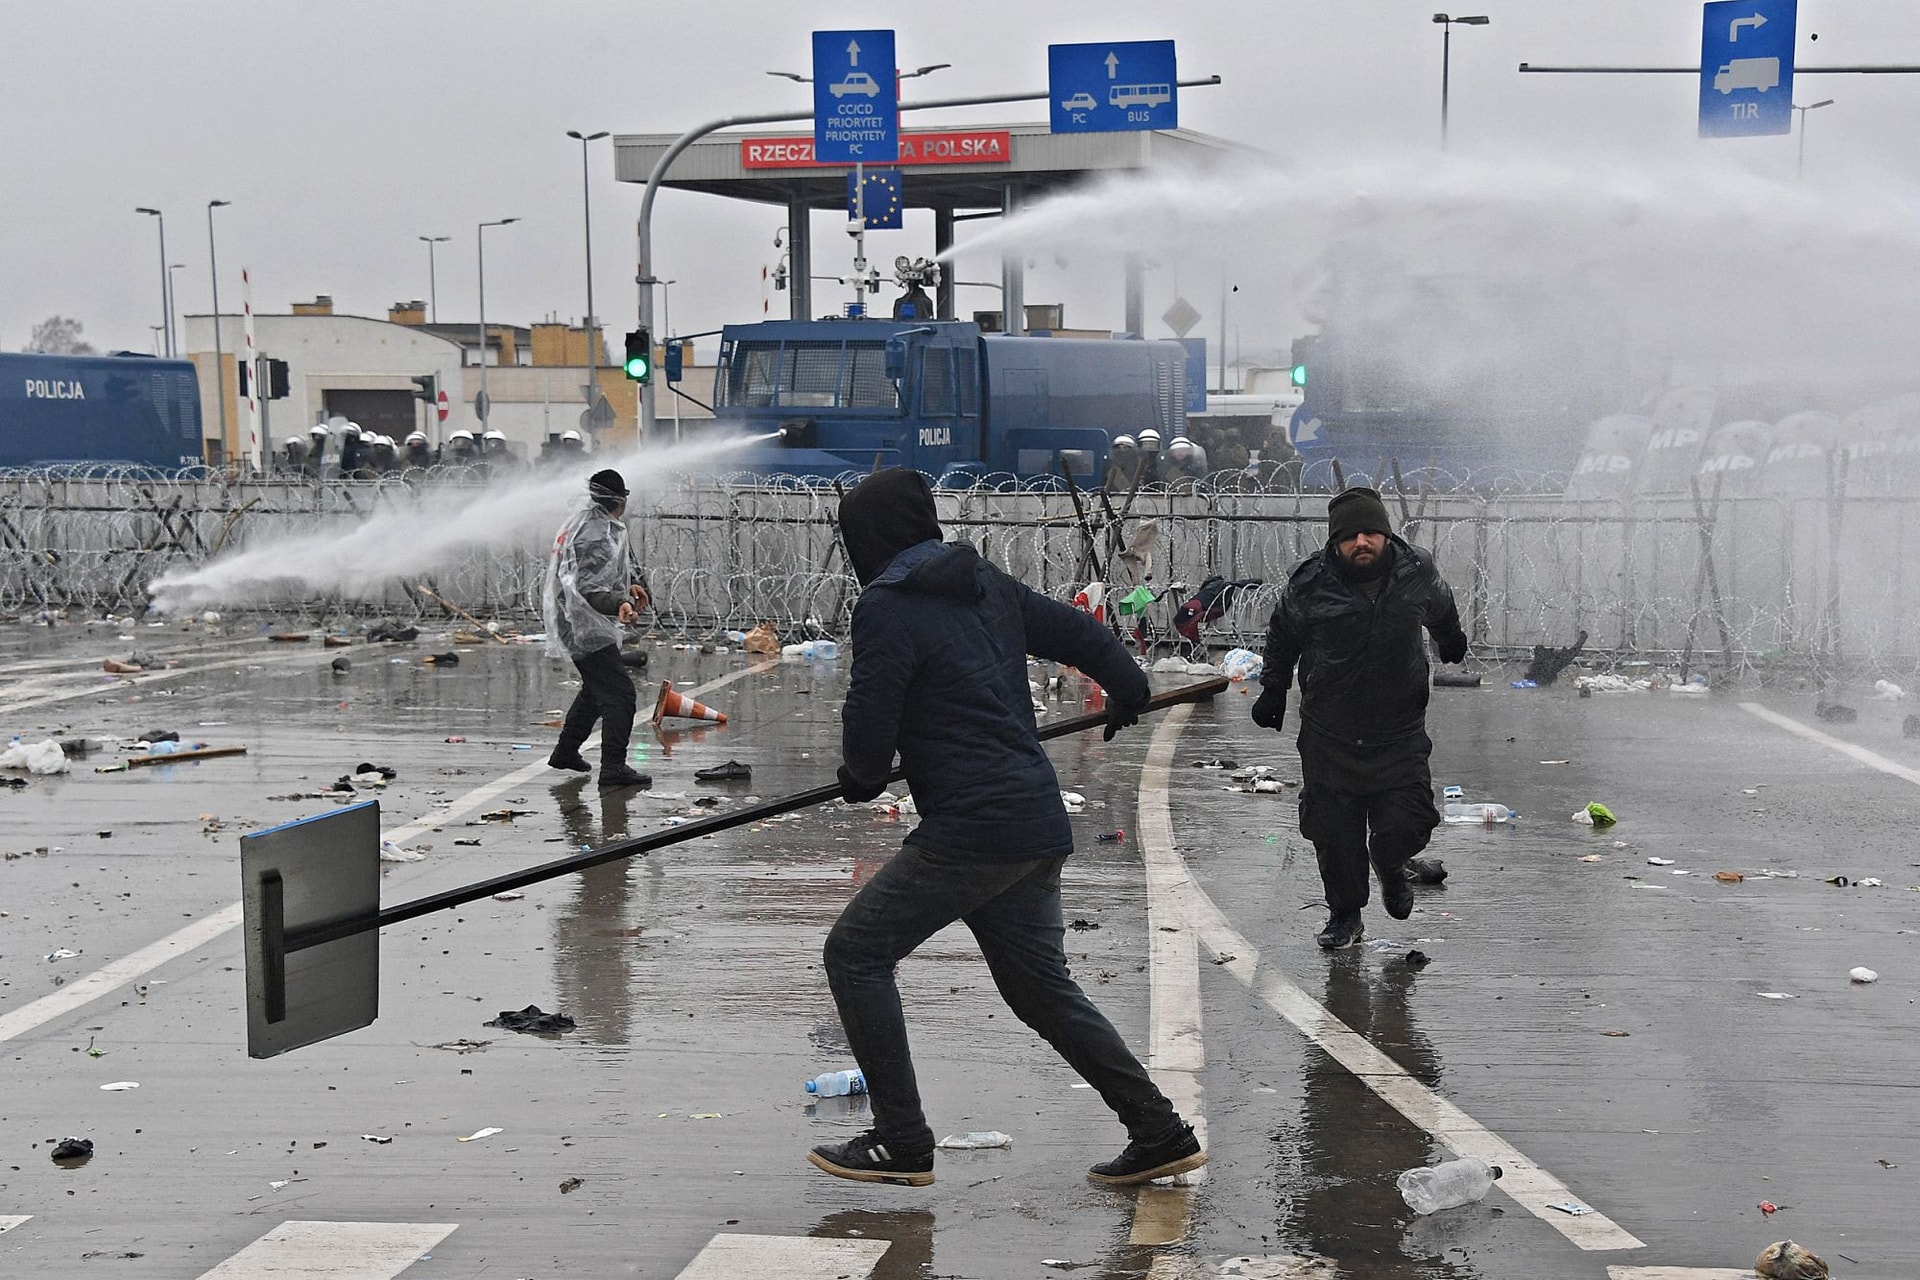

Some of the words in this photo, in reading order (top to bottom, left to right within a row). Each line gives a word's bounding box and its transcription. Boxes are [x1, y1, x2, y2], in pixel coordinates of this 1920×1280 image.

[837, 104, 873, 115] CC/CD
[1731, 104, 1759, 120] TIR
[827, 117, 883, 128] PRIORYTET
[1072, 113, 1087, 124] PC
[1127, 111, 1150, 122] BUS
[825, 131, 886, 142] PRIORYTETY
[849, 144, 864, 154] PC
[923, 138, 1001, 157] POLSKA
[26, 379, 85, 400] POLICJA
[919, 427, 951, 446] POLICJA
[1649, 429, 1700, 451] MP
[1701, 455, 1755, 474] MP
